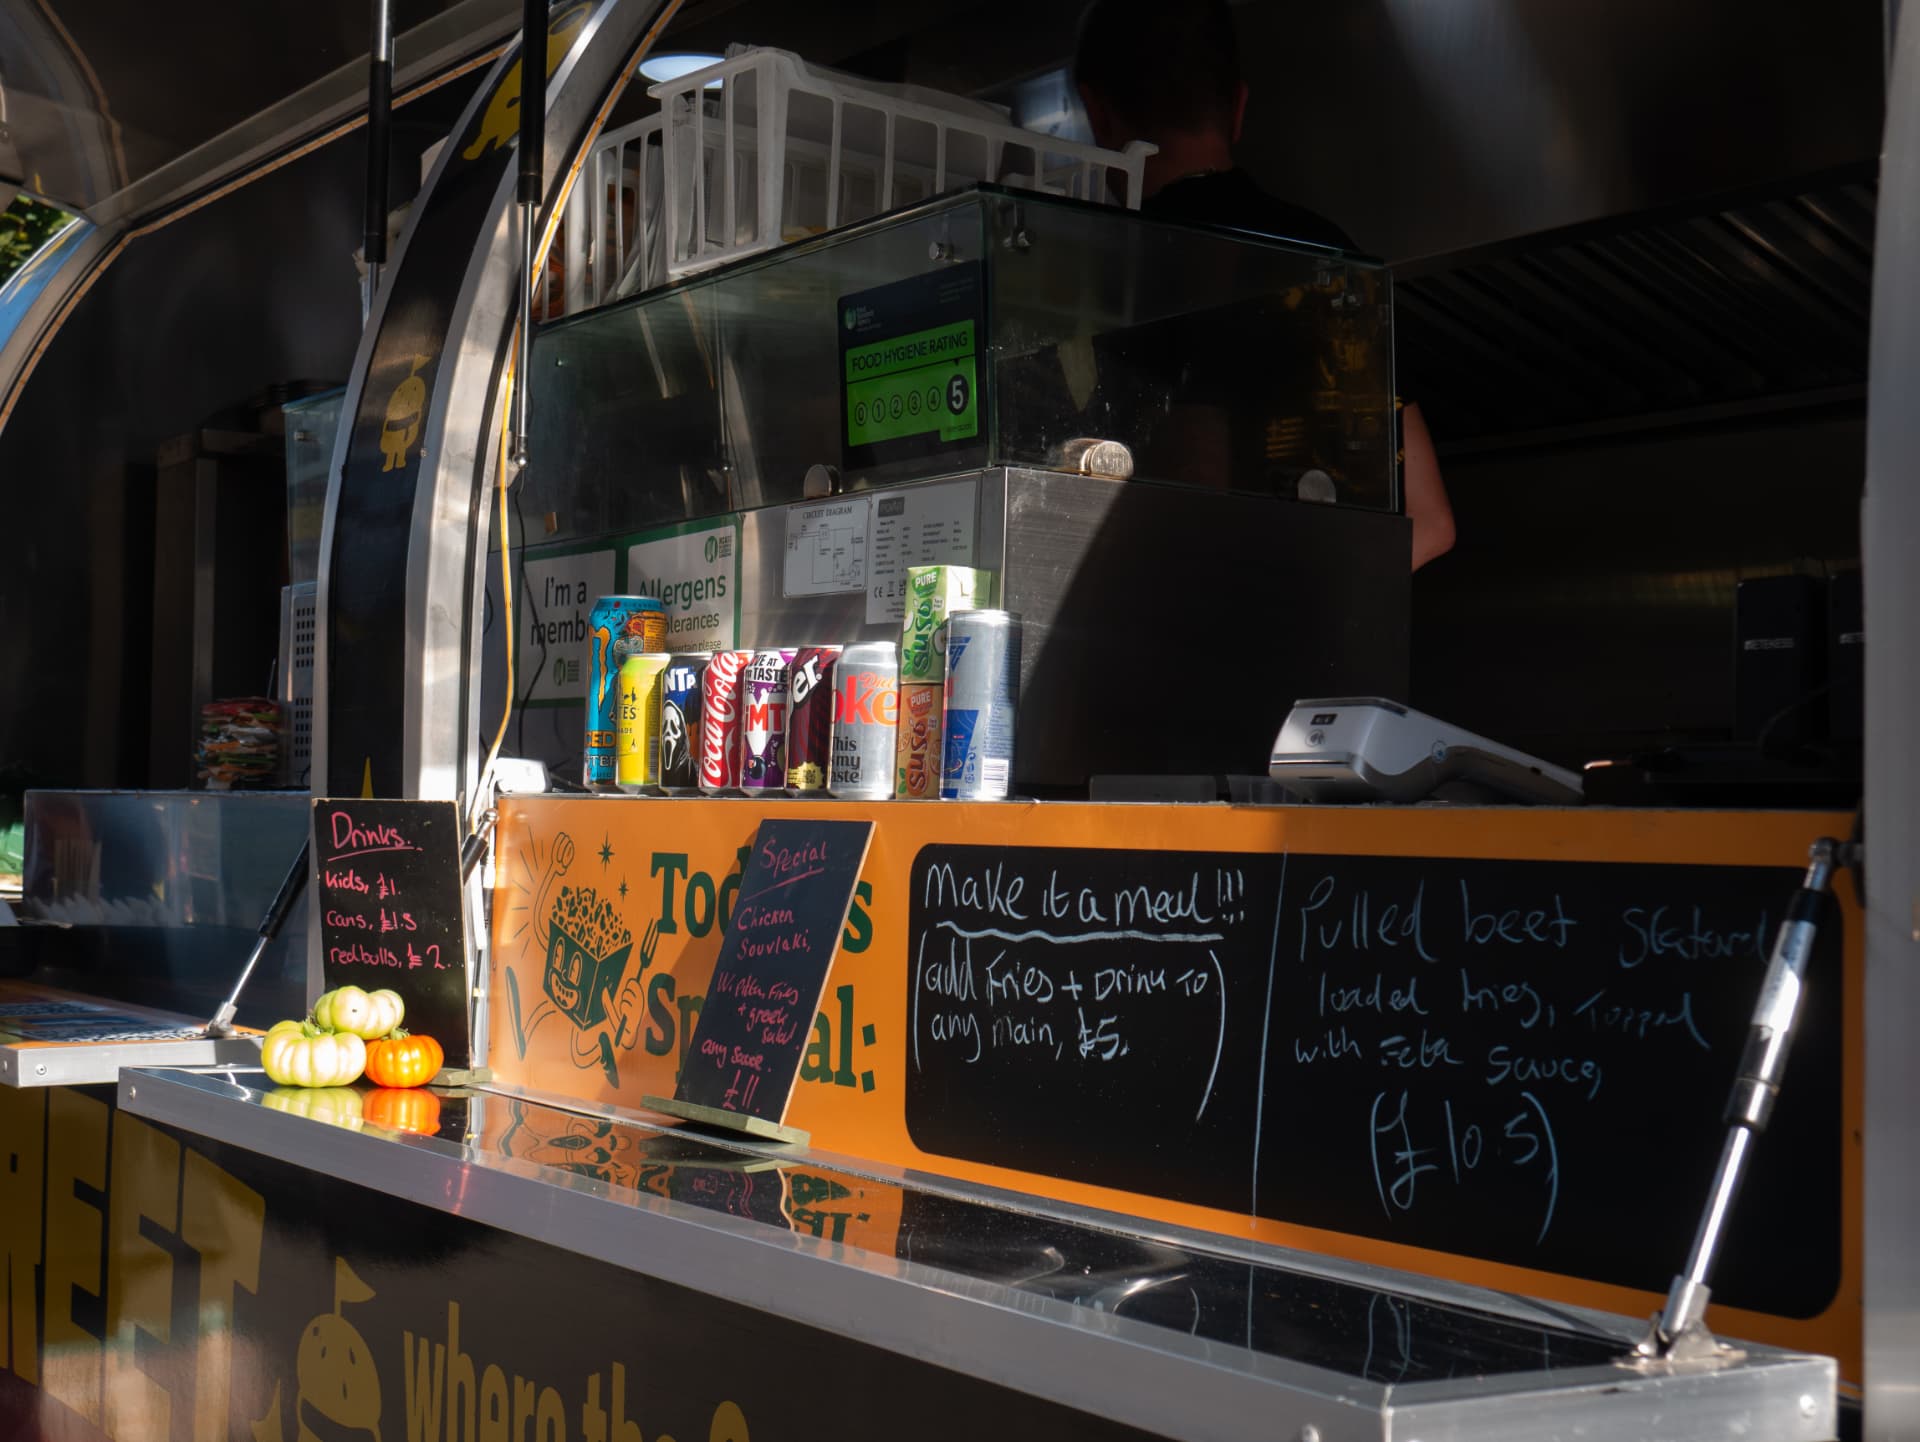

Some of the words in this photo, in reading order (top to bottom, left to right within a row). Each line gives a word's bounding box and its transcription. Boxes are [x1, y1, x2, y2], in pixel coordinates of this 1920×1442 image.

[852, 352, 881, 371] FOOD
[884, 341, 927, 364] HYGIENE
[930, 331, 968, 354] RATING
[951, 380, 964, 410] 5
[545, 576, 571, 608] I'm
[577, 580, 588, 605] a
[639, 574, 726, 610] Allergens
[915, 571, 937, 587] PURE
[753, 667, 788, 682] TASTE
[911, 691, 931, 706] PURE
[924, 861, 1029, 920] Make
[1299, 875, 1440, 963] Pulled
